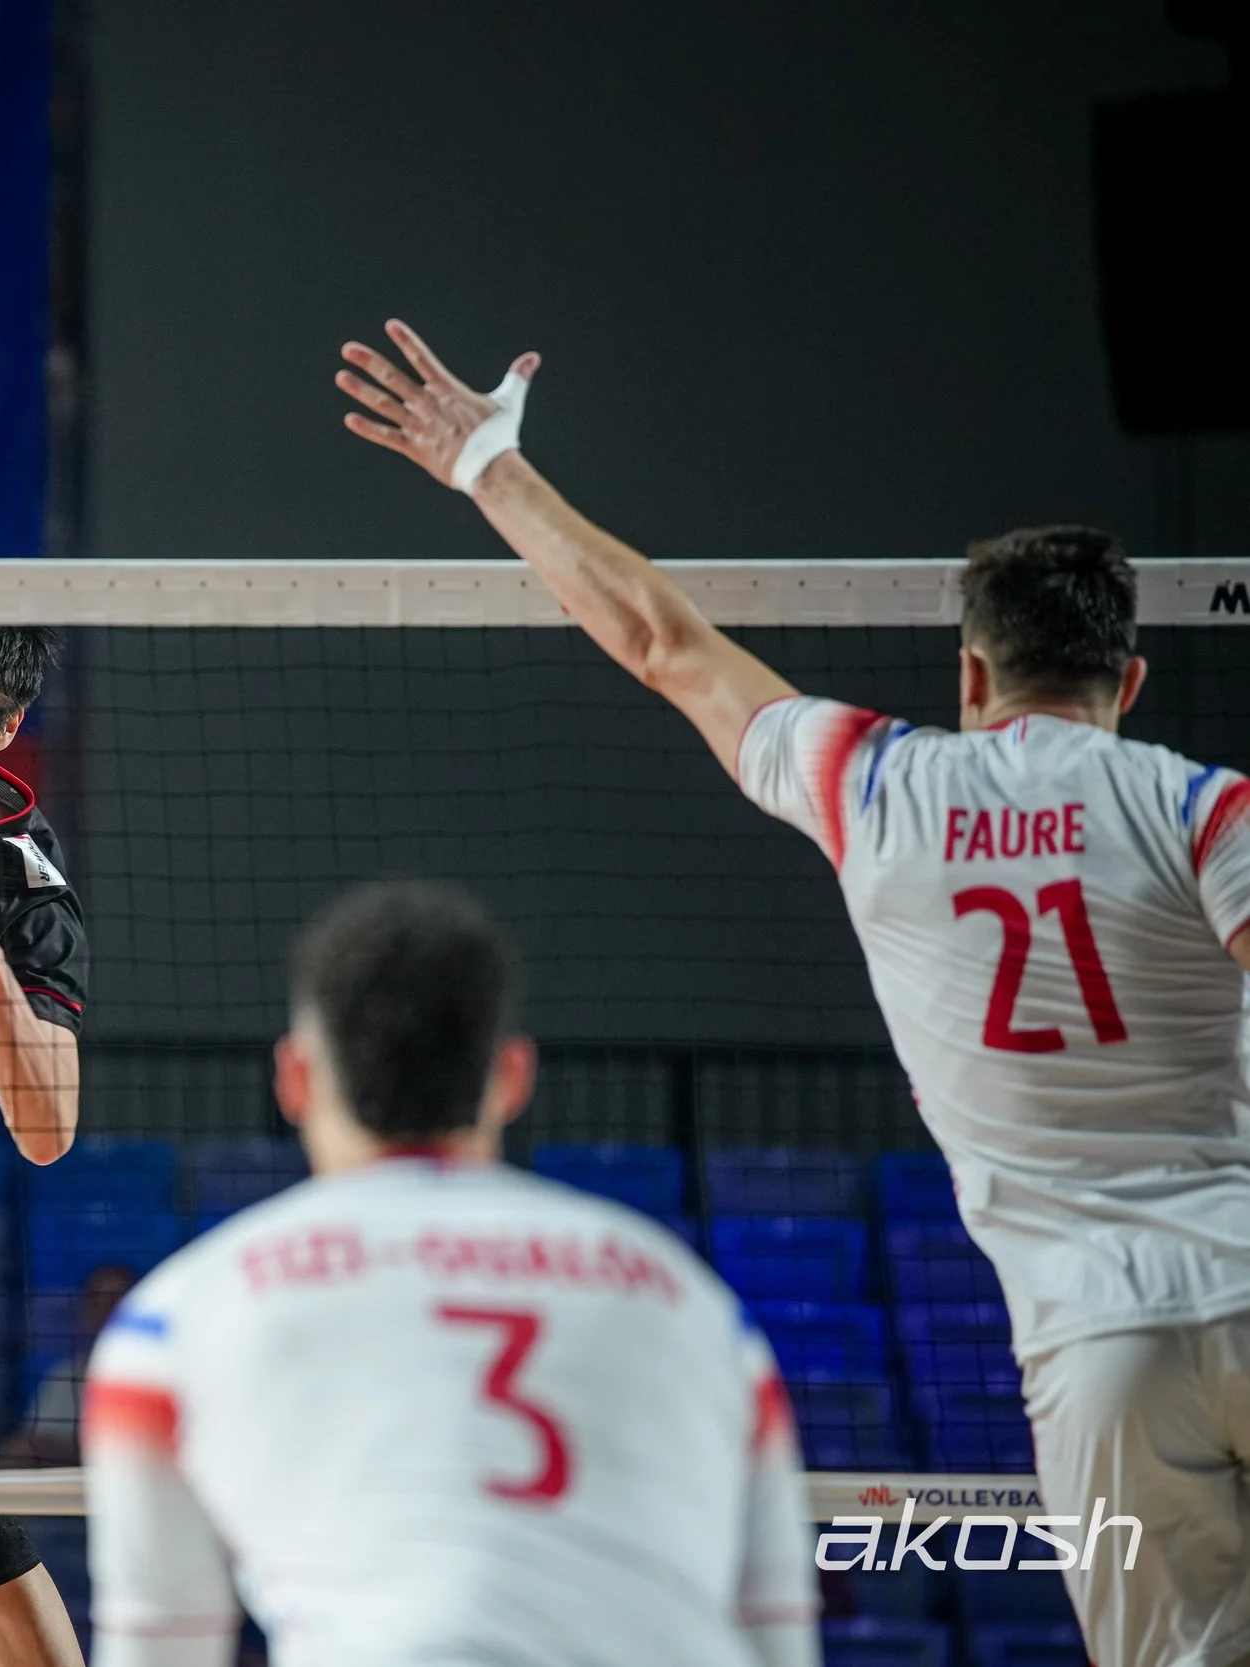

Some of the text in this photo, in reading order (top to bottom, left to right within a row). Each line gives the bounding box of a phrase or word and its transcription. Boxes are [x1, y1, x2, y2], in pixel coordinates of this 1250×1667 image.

[945, 803, 1087, 862] FAURE
[952, 877, 1130, 1054] 21
[432, 1304, 574, 1511] 3
[858, 1485, 1042, 1507] VNL VOLLEYBA
